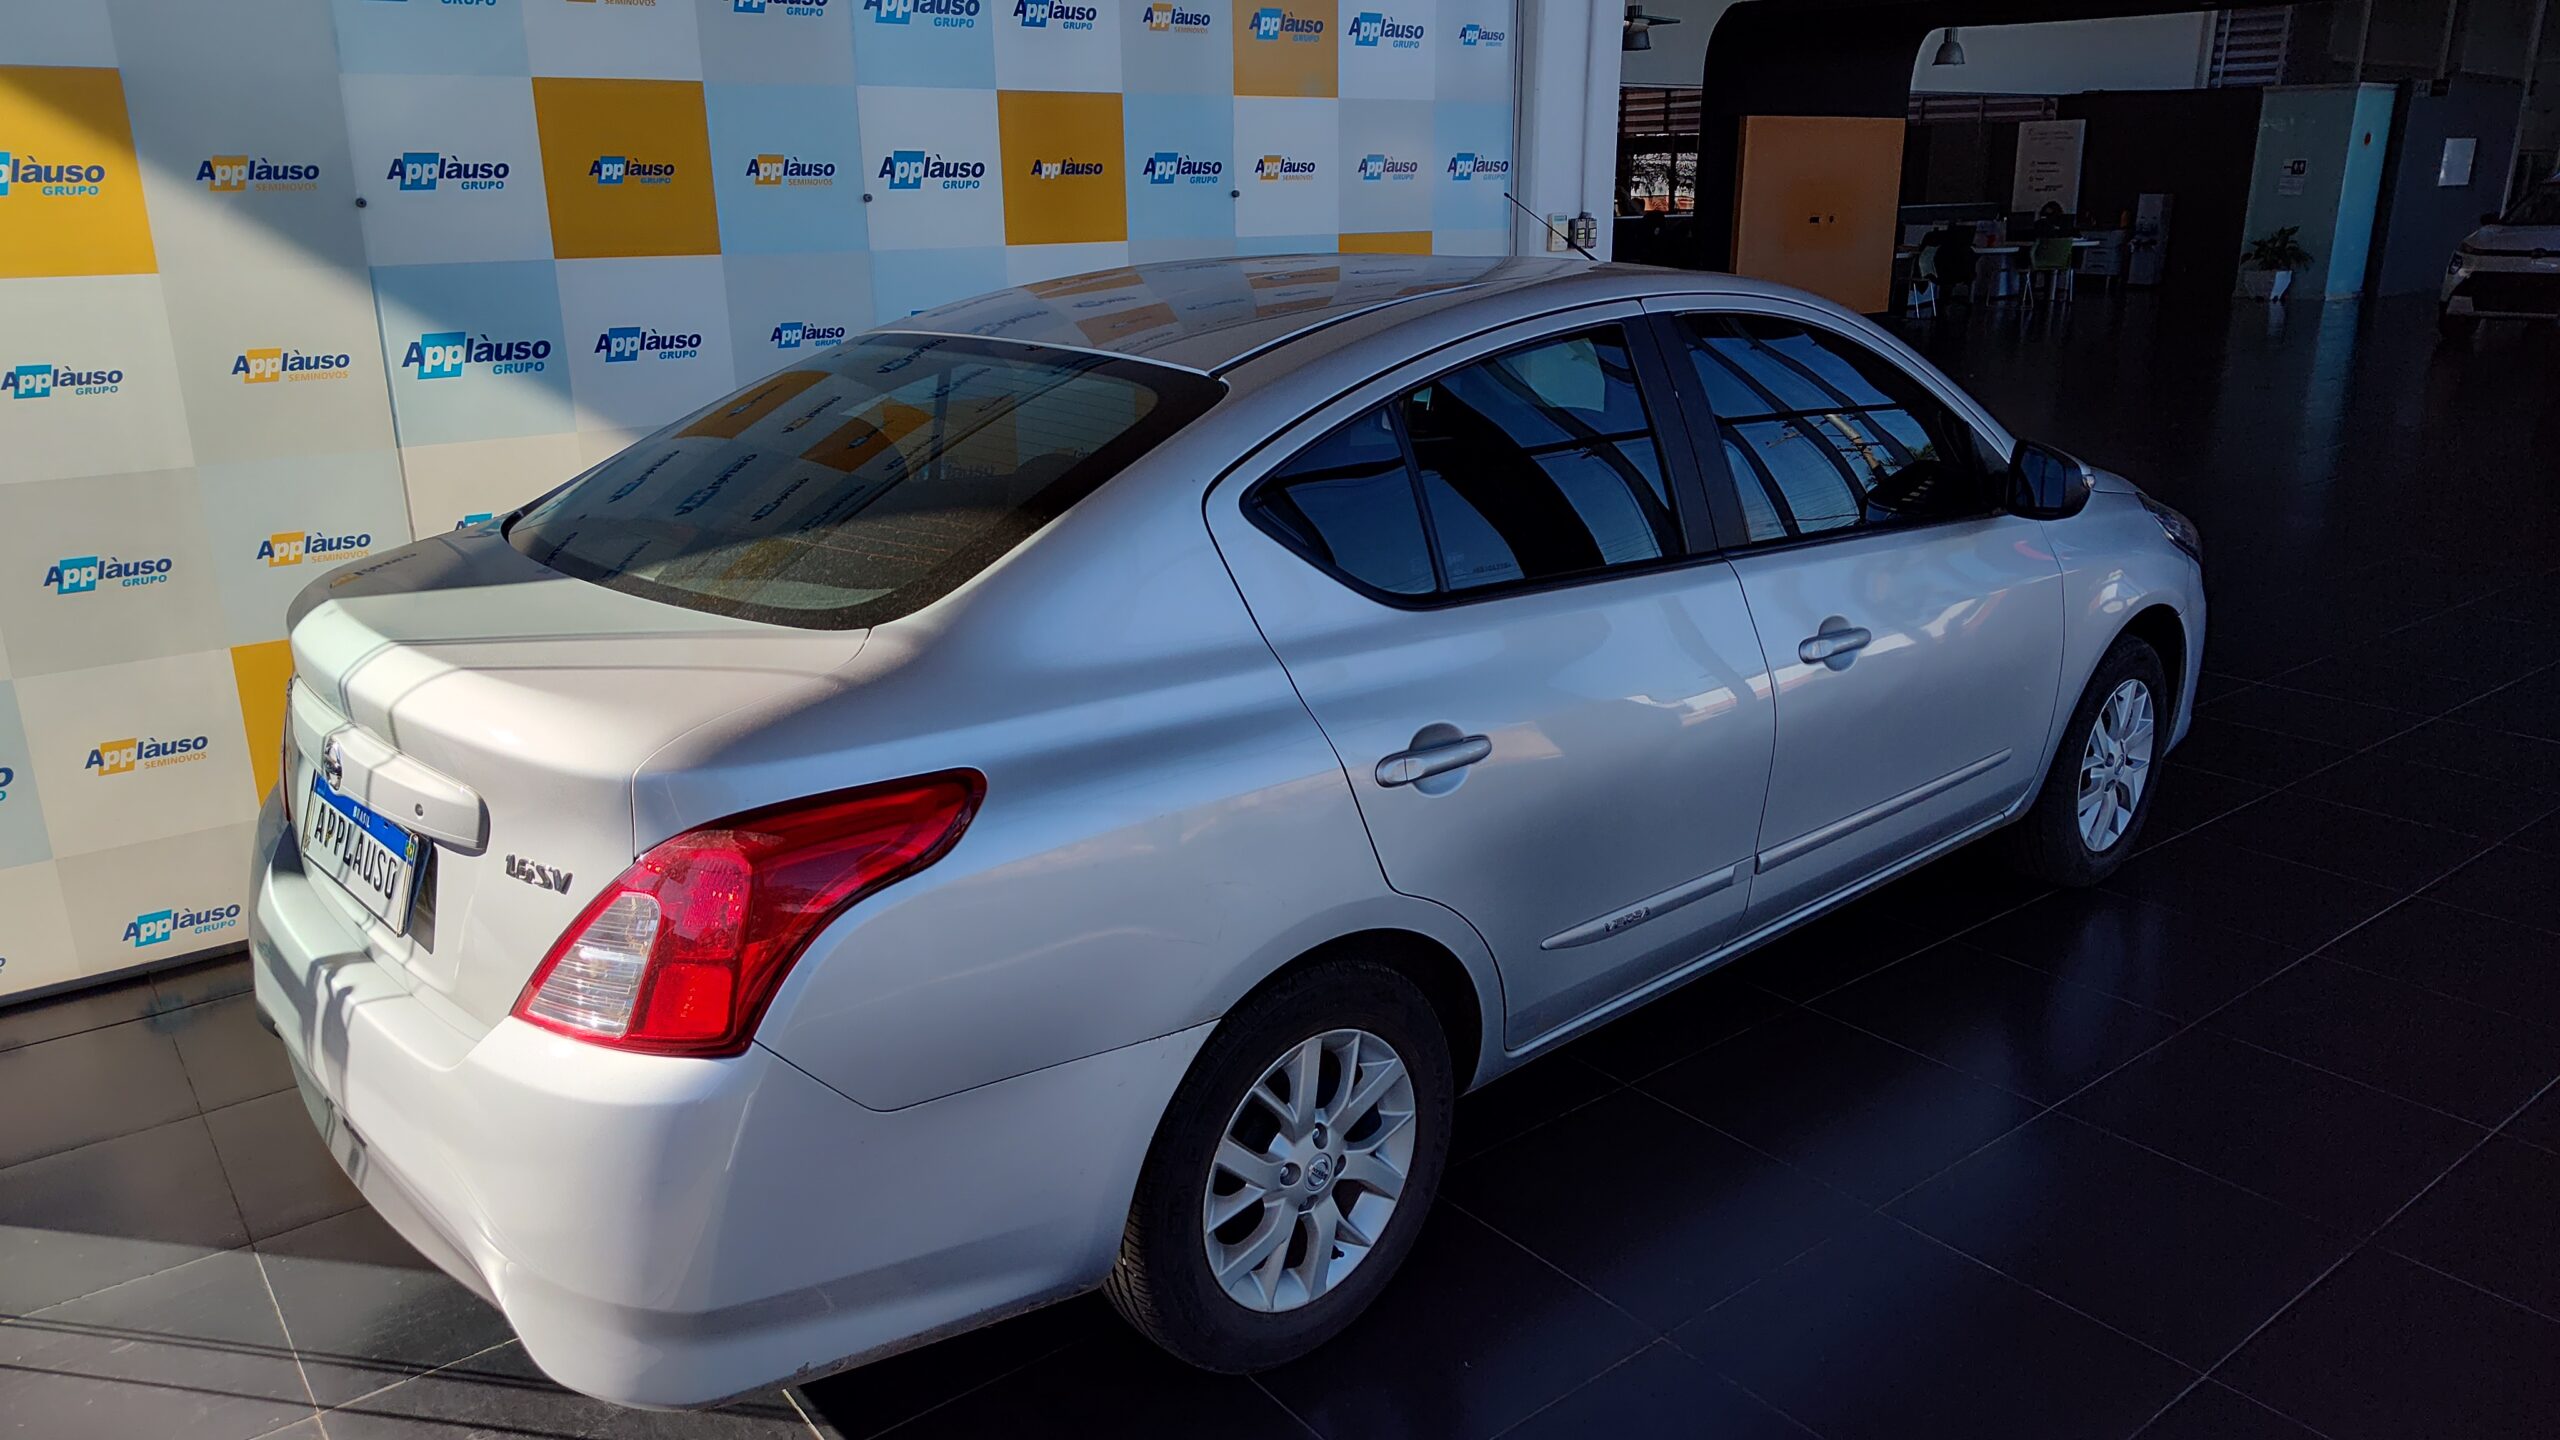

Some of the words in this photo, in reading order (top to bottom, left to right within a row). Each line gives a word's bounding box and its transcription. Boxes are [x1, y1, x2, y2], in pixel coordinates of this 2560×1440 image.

[786, 7, 823, 16] GRUPO
[1013, 0, 1097, 22] Applàuso
[1143, 7, 1210, 28] Applàuso
[933, 17, 975, 28] GRUPO
[1063, 21, 1093, 30] GRUPO
[1249, 12, 1323, 35] Applàuso
[1348, 17, 1424, 46] Applàuso
[1393, 40, 1420, 49] GRUPO
[196, 157, 320, 187] Applàuso
[387, 155, 510, 185] Applàuso
[589, 158, 675, 181] Applàuso
[746, 154, 836, 182] Applàuso
[878, 154, 985, 184] Applàuso
[1030, 157, 1103, 180] Applàuso
[1143, 155, 1222, 182] Applàuso
[1255, 157, 1316, 178] Applàuso
[1358, 156, 1418, 177] Applàuso
[1447, 155, 1509, 177] Applàuso
[42, 185, 99, 196] GRUPO
[255, 181, 318, 191] SEMINOVOS
[461, 180, 504, 190] GRUPO
[942, 180, 980, 189] GRUPO
[1189, 176, 1218, 184] GRUPO
[594, 328, 702, 360] Applàuso
[771, 323, 845, 346] Applàuso
[402, 333, 551, 374] Applàuso
[659, 349, 697, 359] GRUPO
[231, 350, 350, 382] Applàuso
[288, 371, 349, 382] SEMINOVOS
[492, 361, 545, 375] GRUPO
[1, 366, 123, 395] Applàuso
[75, 385, 118, 395] GRUPO
[256, 532, 371, 563] Applàuso
[310, 549, 369, 564] SEMINOVOS
[43, 556, 172, 590] Applàuso
[122, 573, 167, 587] GRUPO
[85, 735, 208, 772] Applàuso
[144, 751, 207, 769] SEMINOVOS
[314, 802, 399, 900] APPLAUSO
[122, 903, 241, 943] Applàuso
[194, 919, 236, 935] GRUPO
